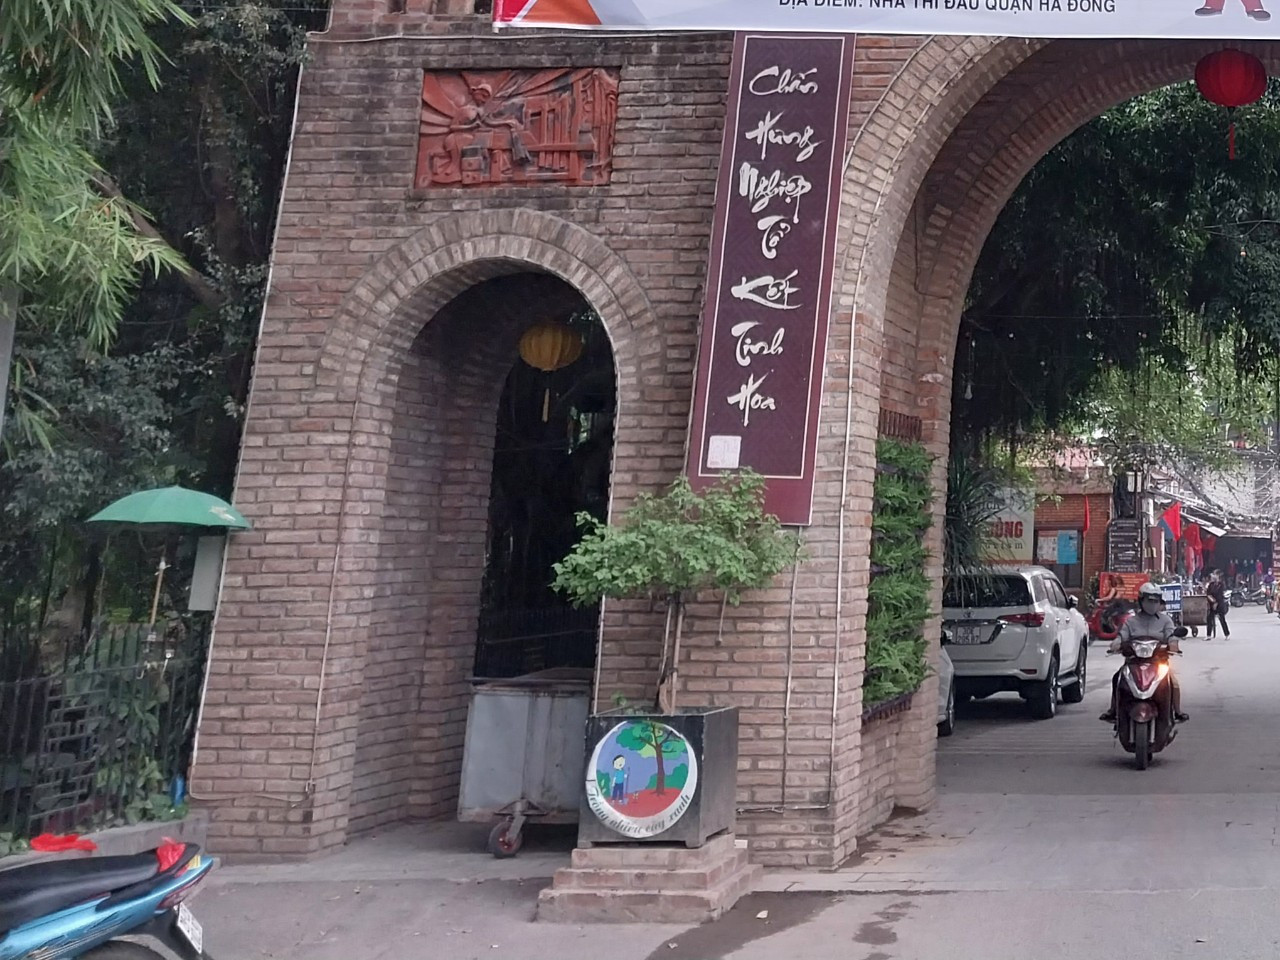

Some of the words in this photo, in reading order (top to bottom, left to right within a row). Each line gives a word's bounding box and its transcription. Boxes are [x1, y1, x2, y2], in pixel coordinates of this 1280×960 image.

[749, 66, 818, 95] Chấn
[740, 162, 812, 224] Nghiệp
[731, 322, 785, 367] Tinh
[727, 373, 776, 427] Hoa
